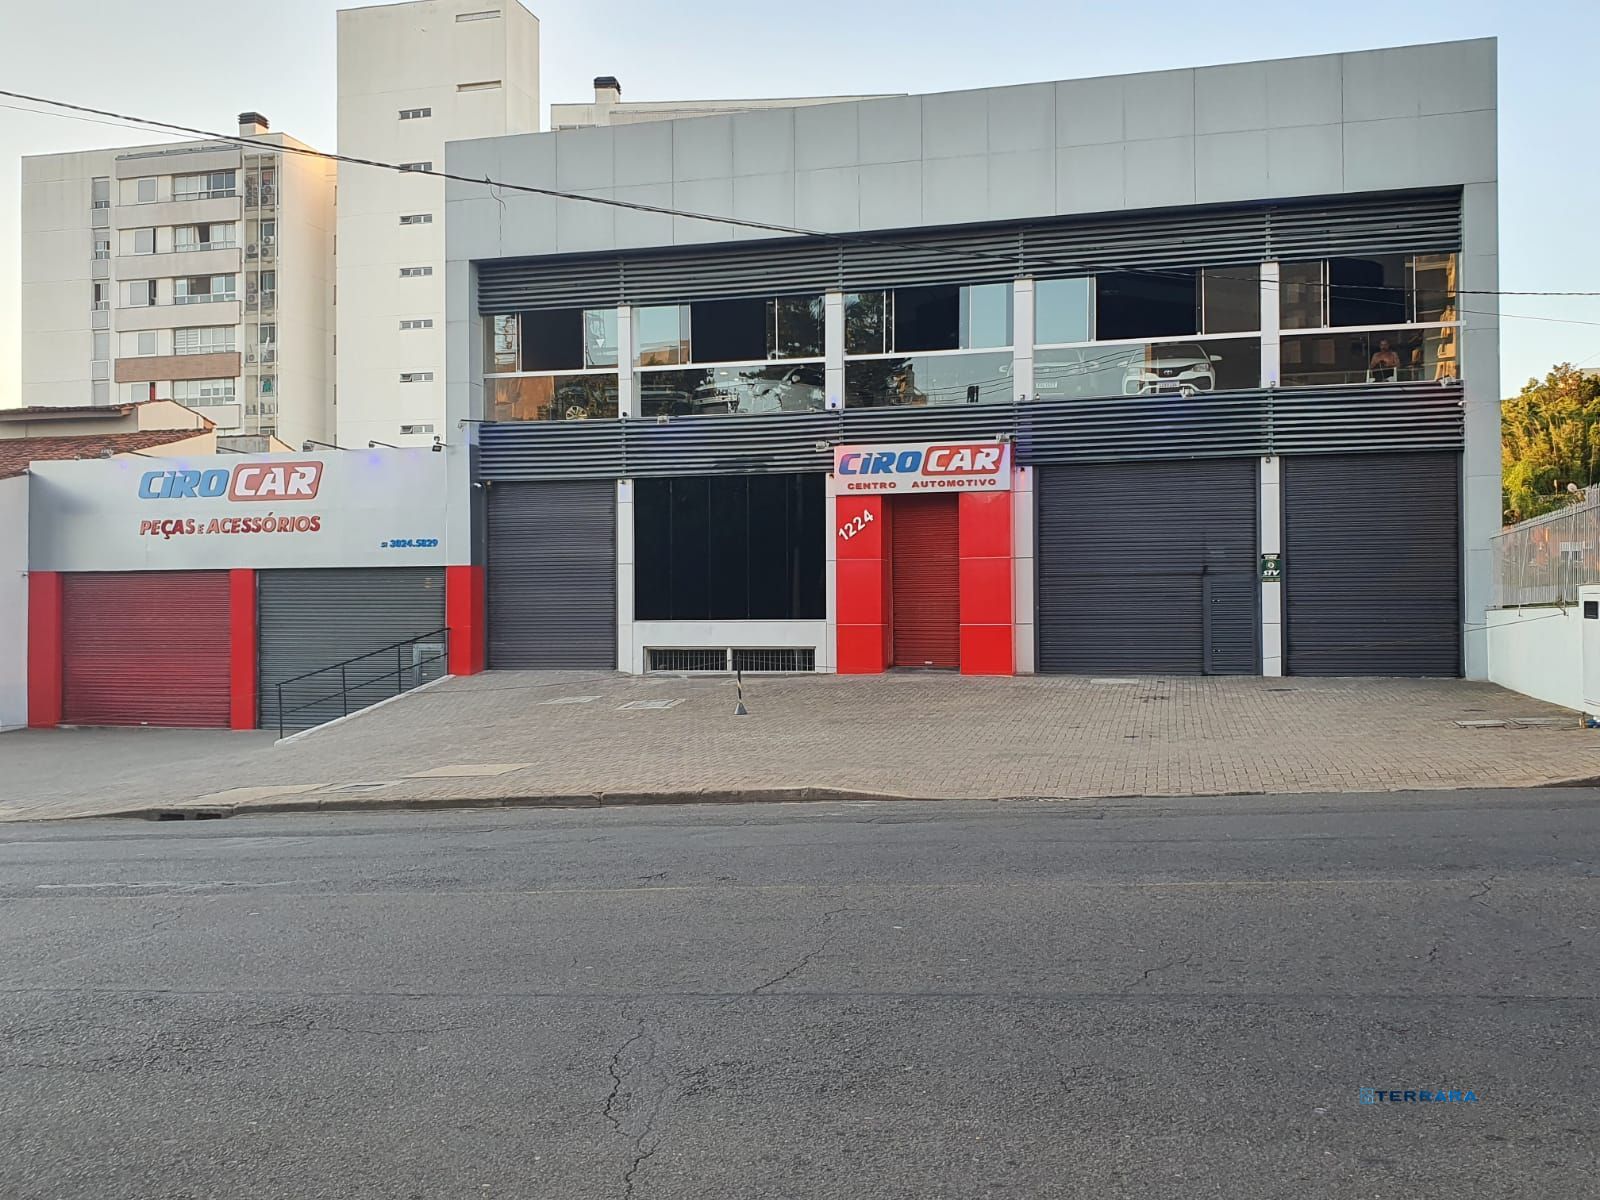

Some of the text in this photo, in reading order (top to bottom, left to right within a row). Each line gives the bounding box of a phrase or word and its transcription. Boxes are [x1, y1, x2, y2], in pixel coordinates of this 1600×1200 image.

[838, 447, 1000, 475] CIRO CAR
[138, 466, 318, 499] CIRO CAR
[847, 478, 997, 490] CENTRO AUTOMOTIVO
[139, 512, 321, 539] PEÇAS E ACESSÓRIOS
[838, 508, 874, 541] 1224
